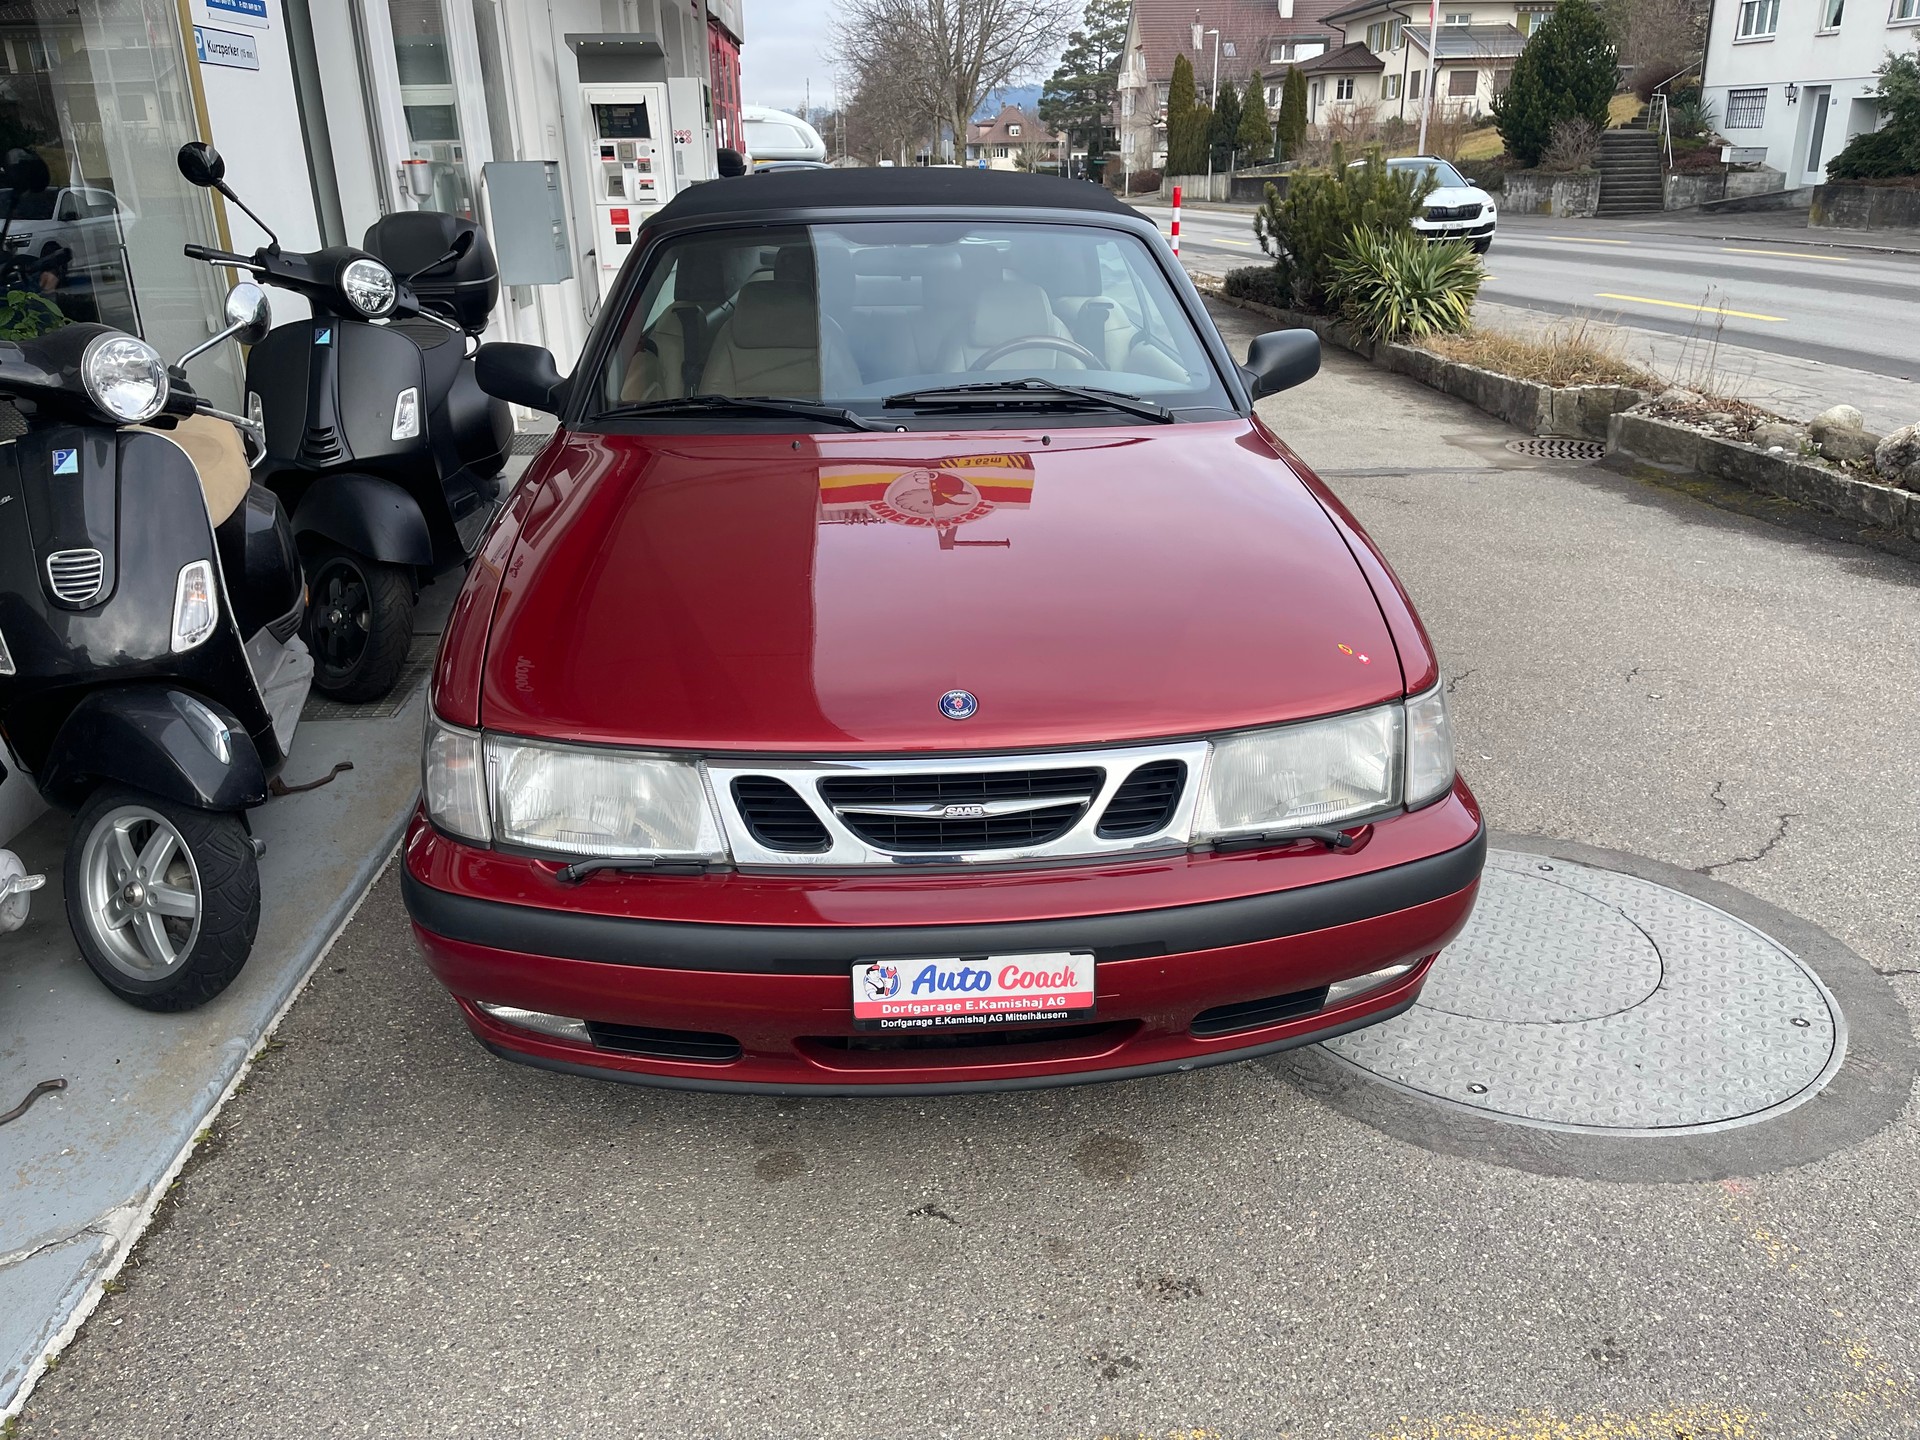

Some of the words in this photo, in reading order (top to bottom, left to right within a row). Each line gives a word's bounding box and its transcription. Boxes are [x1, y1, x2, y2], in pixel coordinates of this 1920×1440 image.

[207, 40, 239, 57] Kurzparker
[946, 807, 982, 816] SAAB
[911, 965, 992, 995] Auto
[998, 965, 1078, 990] Coach
[882, 1001, 961, 1014] Dorfgarage
[966, 998, 1043, 1011] E.Kamishaj
[1047, 996, 1066, 1006] AG
[881, 1017, 933, 1028] Dorfgarage
[935, 1015, 987, 1025] E.Kamishaj
[989, 1014, 1003, 1022] AG
[1005, 1011, 1068, 1022] Mittelhäusern
